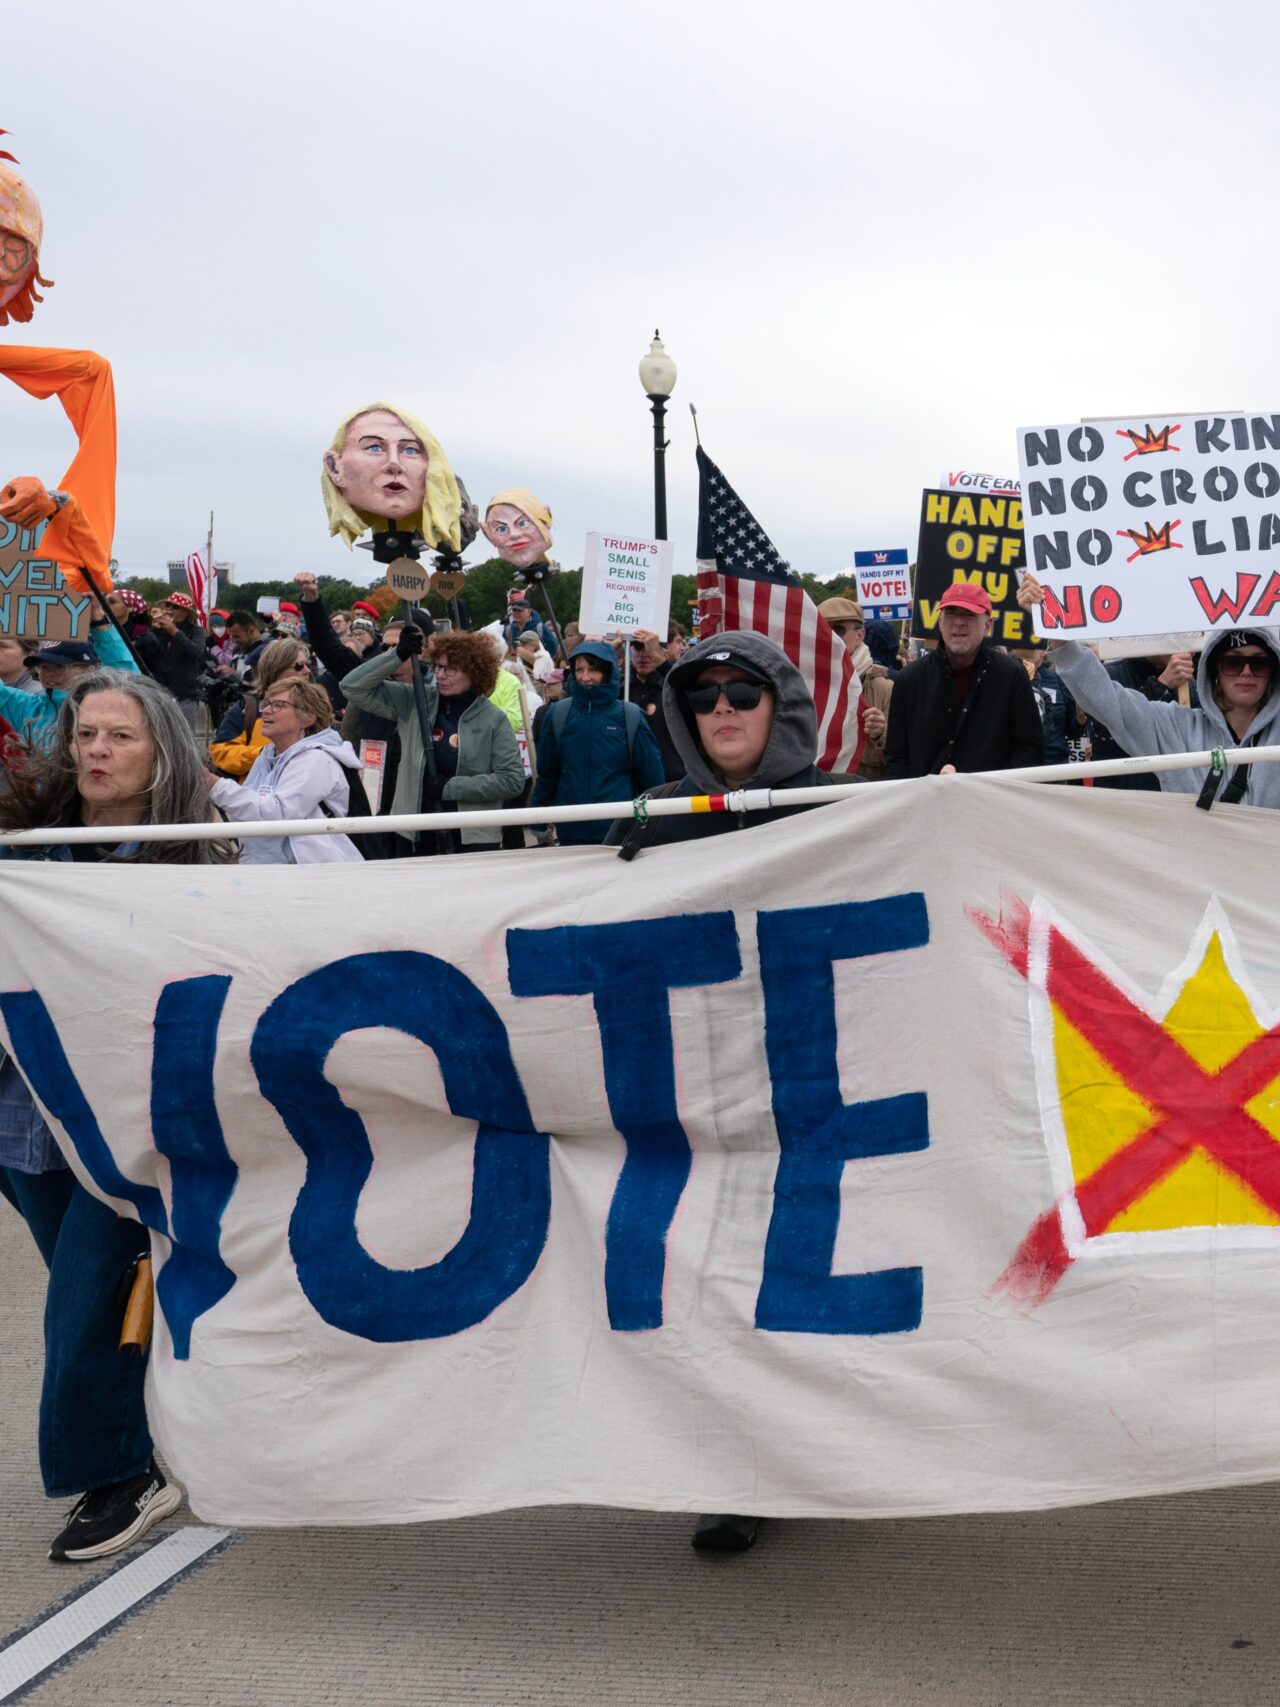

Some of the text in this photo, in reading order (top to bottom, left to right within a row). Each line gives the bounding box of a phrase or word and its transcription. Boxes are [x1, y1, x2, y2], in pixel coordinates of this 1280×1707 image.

[1025, 426, 1104, 466] NO
[949, 470, 989, 489] VOTE
[1028, 475, 1107, 516] NO
[602, 538, 658, 555] TRUMP'S
[946, 531, 1021, 565] OFF
[1033, 528, 1112, 571] NO
[608, 553, 650, 568] SMALL
[392, 574, 426, 591] HARPY
[609, 567, 646, 581] PENIS
[605, 582, 646, 593] REQUIRES
[861, 580, 907, 598] VOTE!
[614, 602, 634, 612] BIG
[1040, 585, 1122, 628] NO
[607, 614, 639, 625] ARCH
[0, 892, 930, 1360] VOTE
[135, 1480, 159, 1513] HOKA
